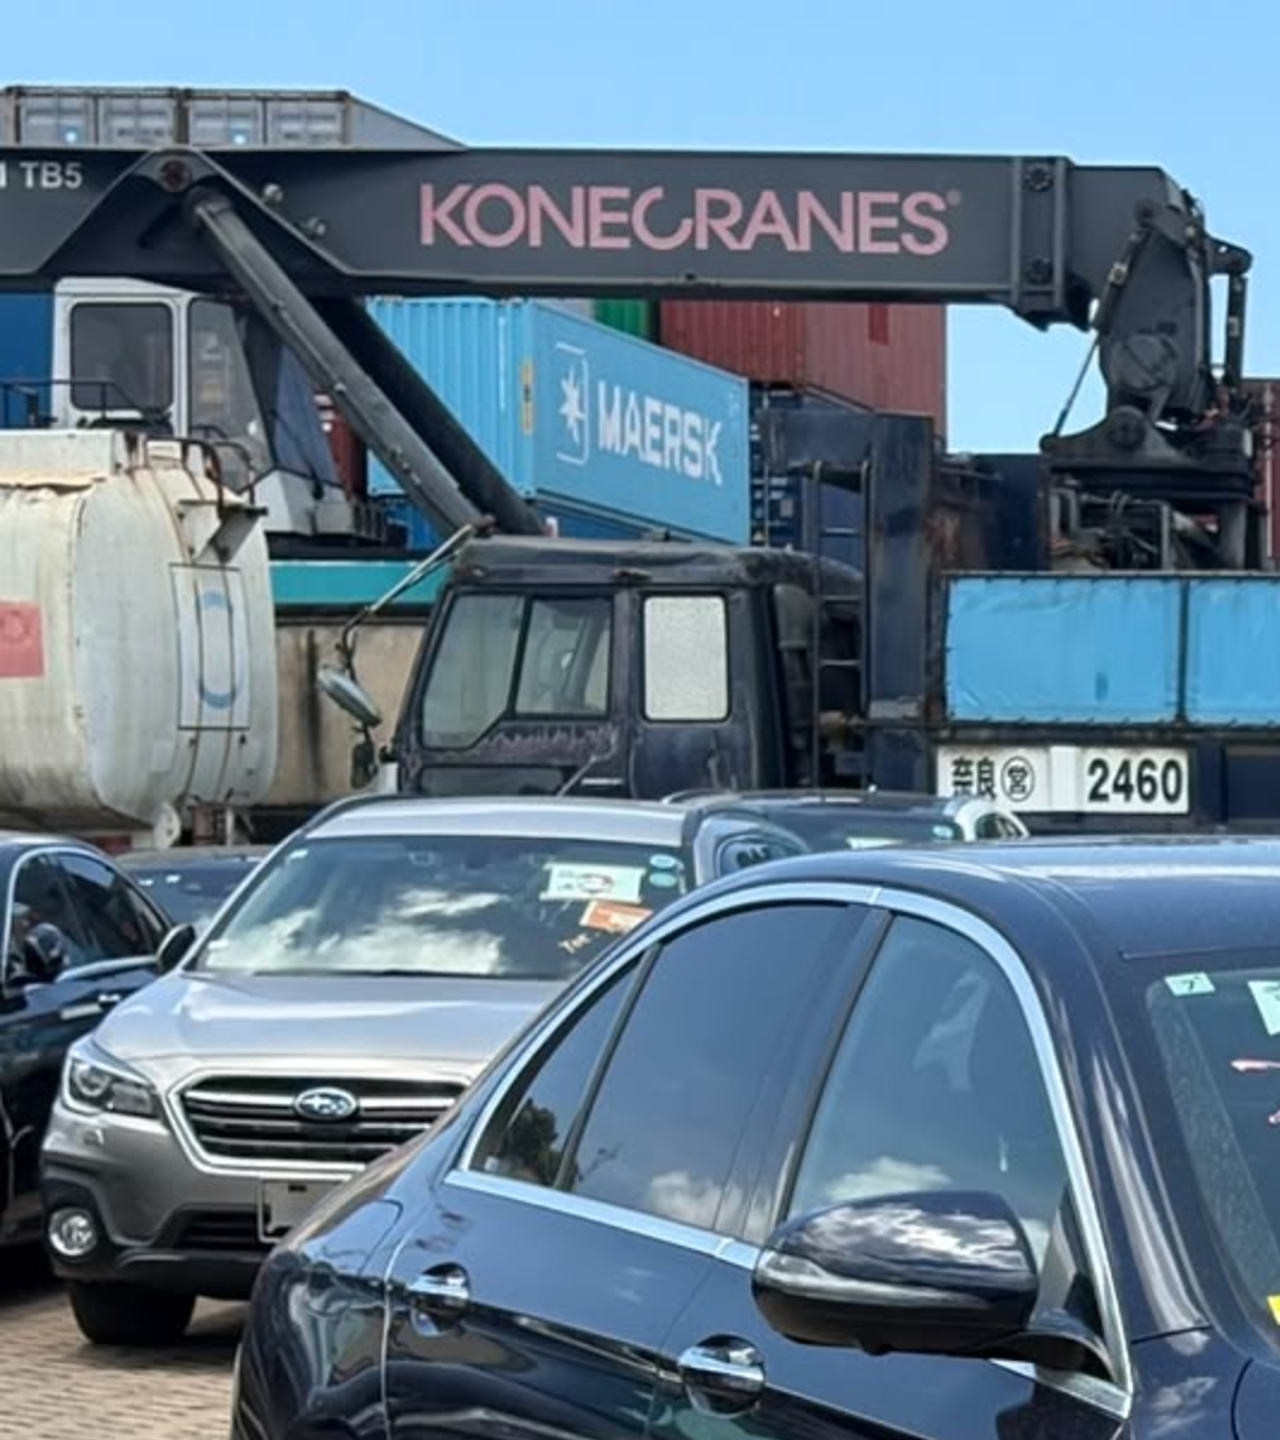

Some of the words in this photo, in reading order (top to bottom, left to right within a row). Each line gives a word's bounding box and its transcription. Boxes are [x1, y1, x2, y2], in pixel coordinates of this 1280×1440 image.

[19, 160, 83, 189] TB5
[420, 183, 950, 256] KONECRANES
[597, 379, 723, 487] MAERSK
[1086, 757, 1184, 803] 2460
